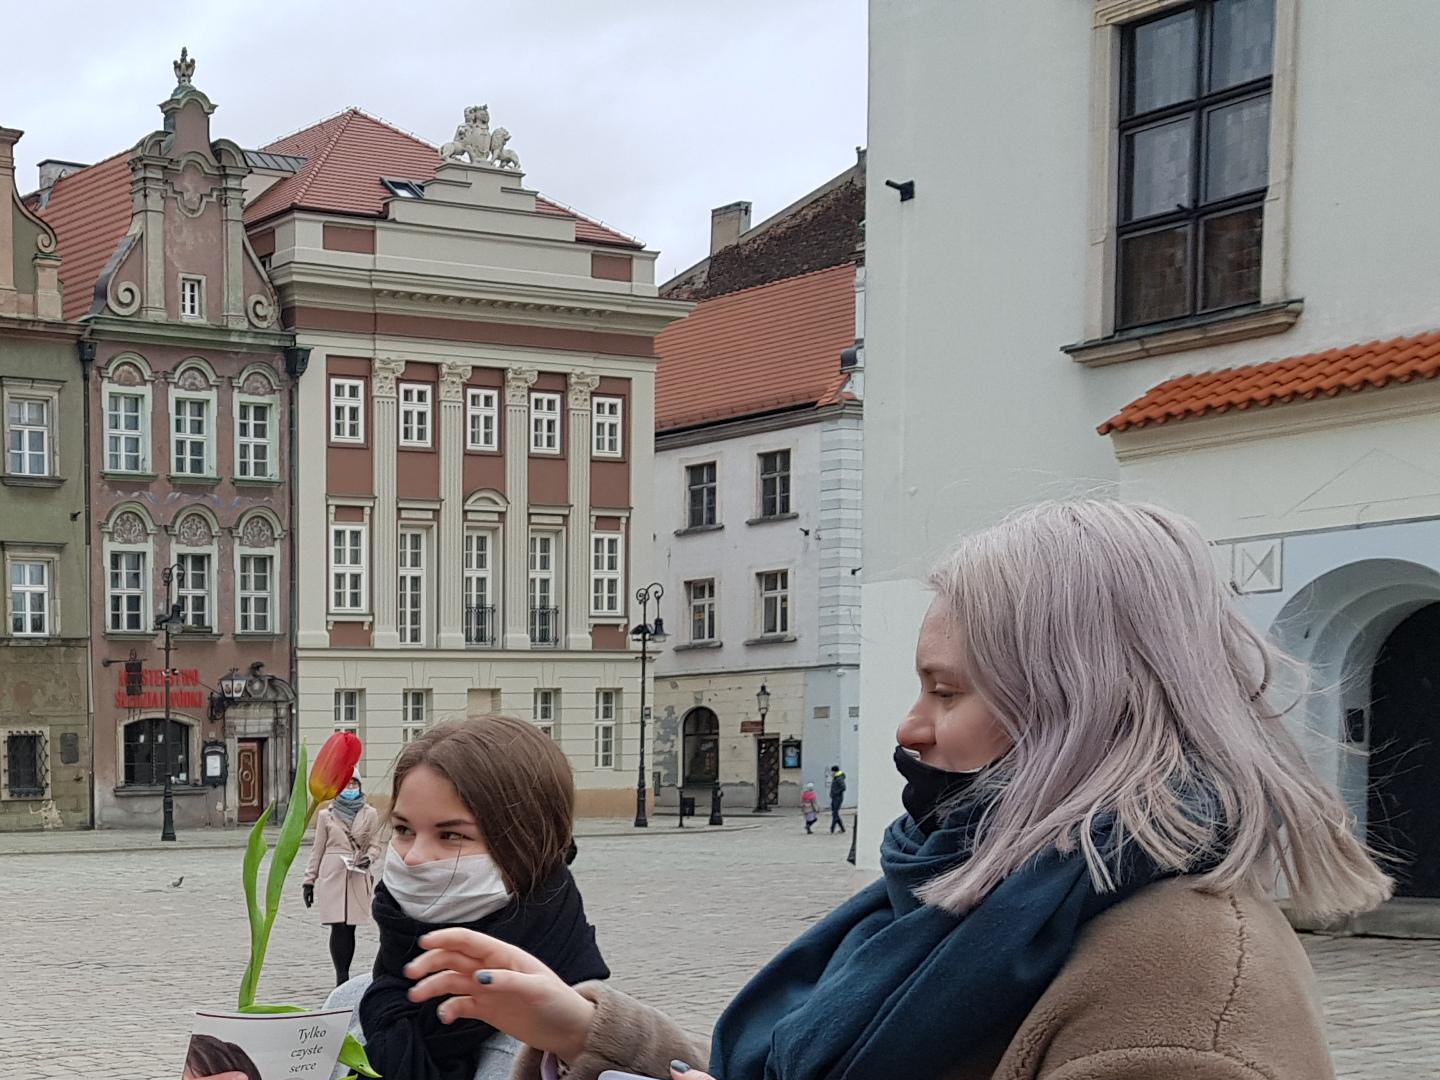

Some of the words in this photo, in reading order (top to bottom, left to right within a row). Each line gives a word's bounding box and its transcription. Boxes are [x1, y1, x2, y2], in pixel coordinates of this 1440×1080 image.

[298, 1025, 327, 1044] Tylko
[290, 1044, 324, 1061] czyste
[289, 1062, 317, 1073] serce
